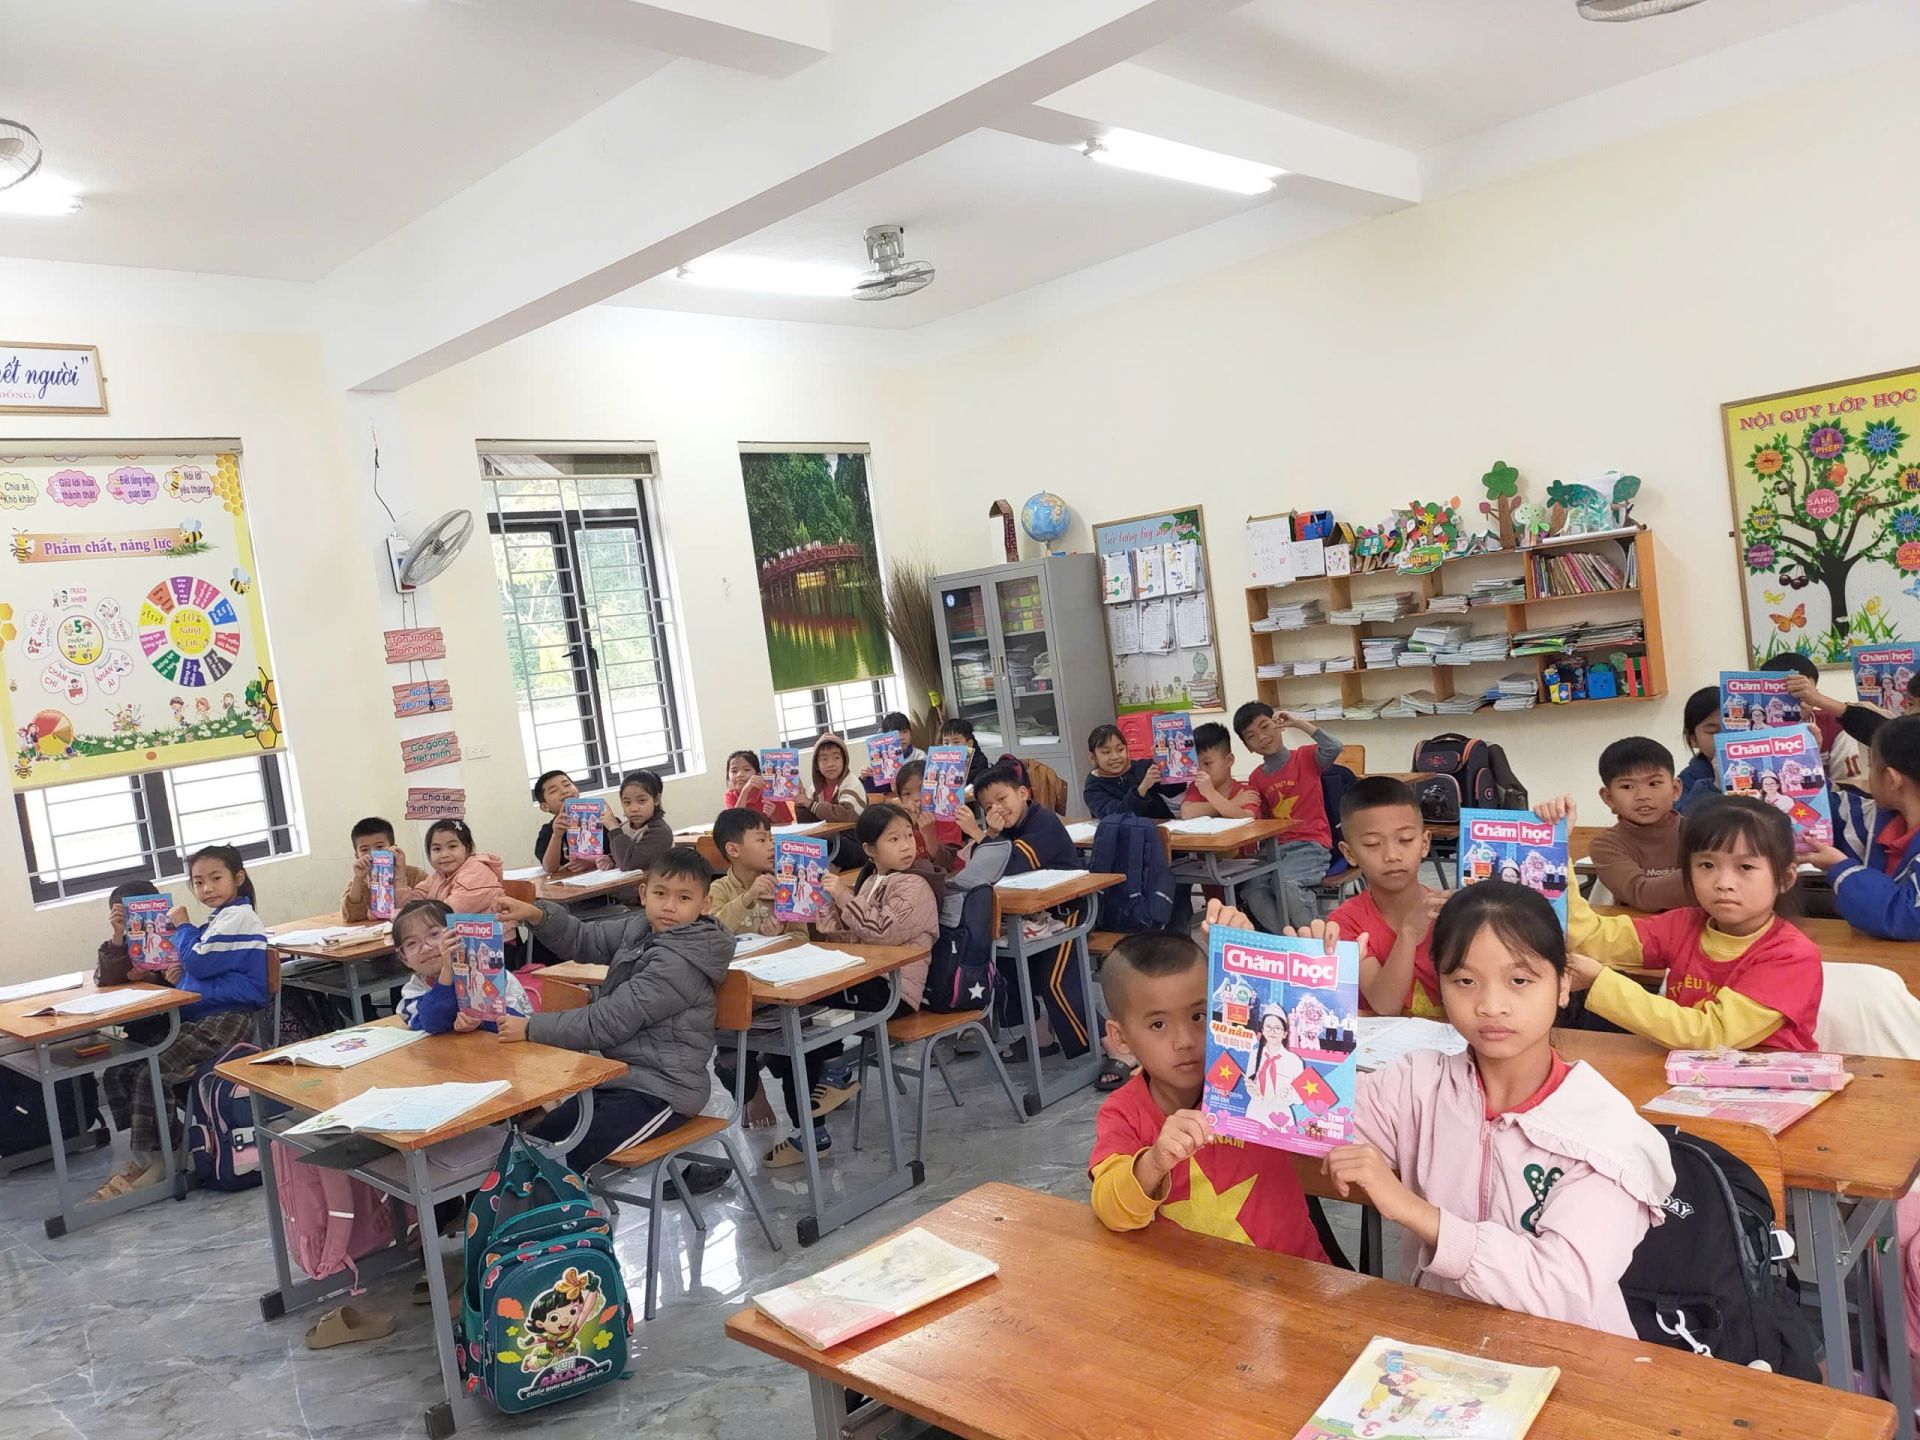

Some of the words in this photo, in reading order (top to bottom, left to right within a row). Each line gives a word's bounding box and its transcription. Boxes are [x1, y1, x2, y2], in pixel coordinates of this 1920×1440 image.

[0, 356, 22, 384] ết
[1739, 411, 1776, 431] NỘI
[1779, 404, 1822, 423] QUY
[1827, 396, 1868, 416] LỚP
[1872, 388, 1918, 409] HỌC
[74, 619, 83, 633] 5
[1729, 744, 1771, 756] Chăm
[1774, 740, 1803, 753] học
[1473, 823, 1517, 838] Chăm
[1522, 826, 1552, 843] học
[1227, 949, 1285, 975] Chăm
[1292, 959, 1334, 984] học
